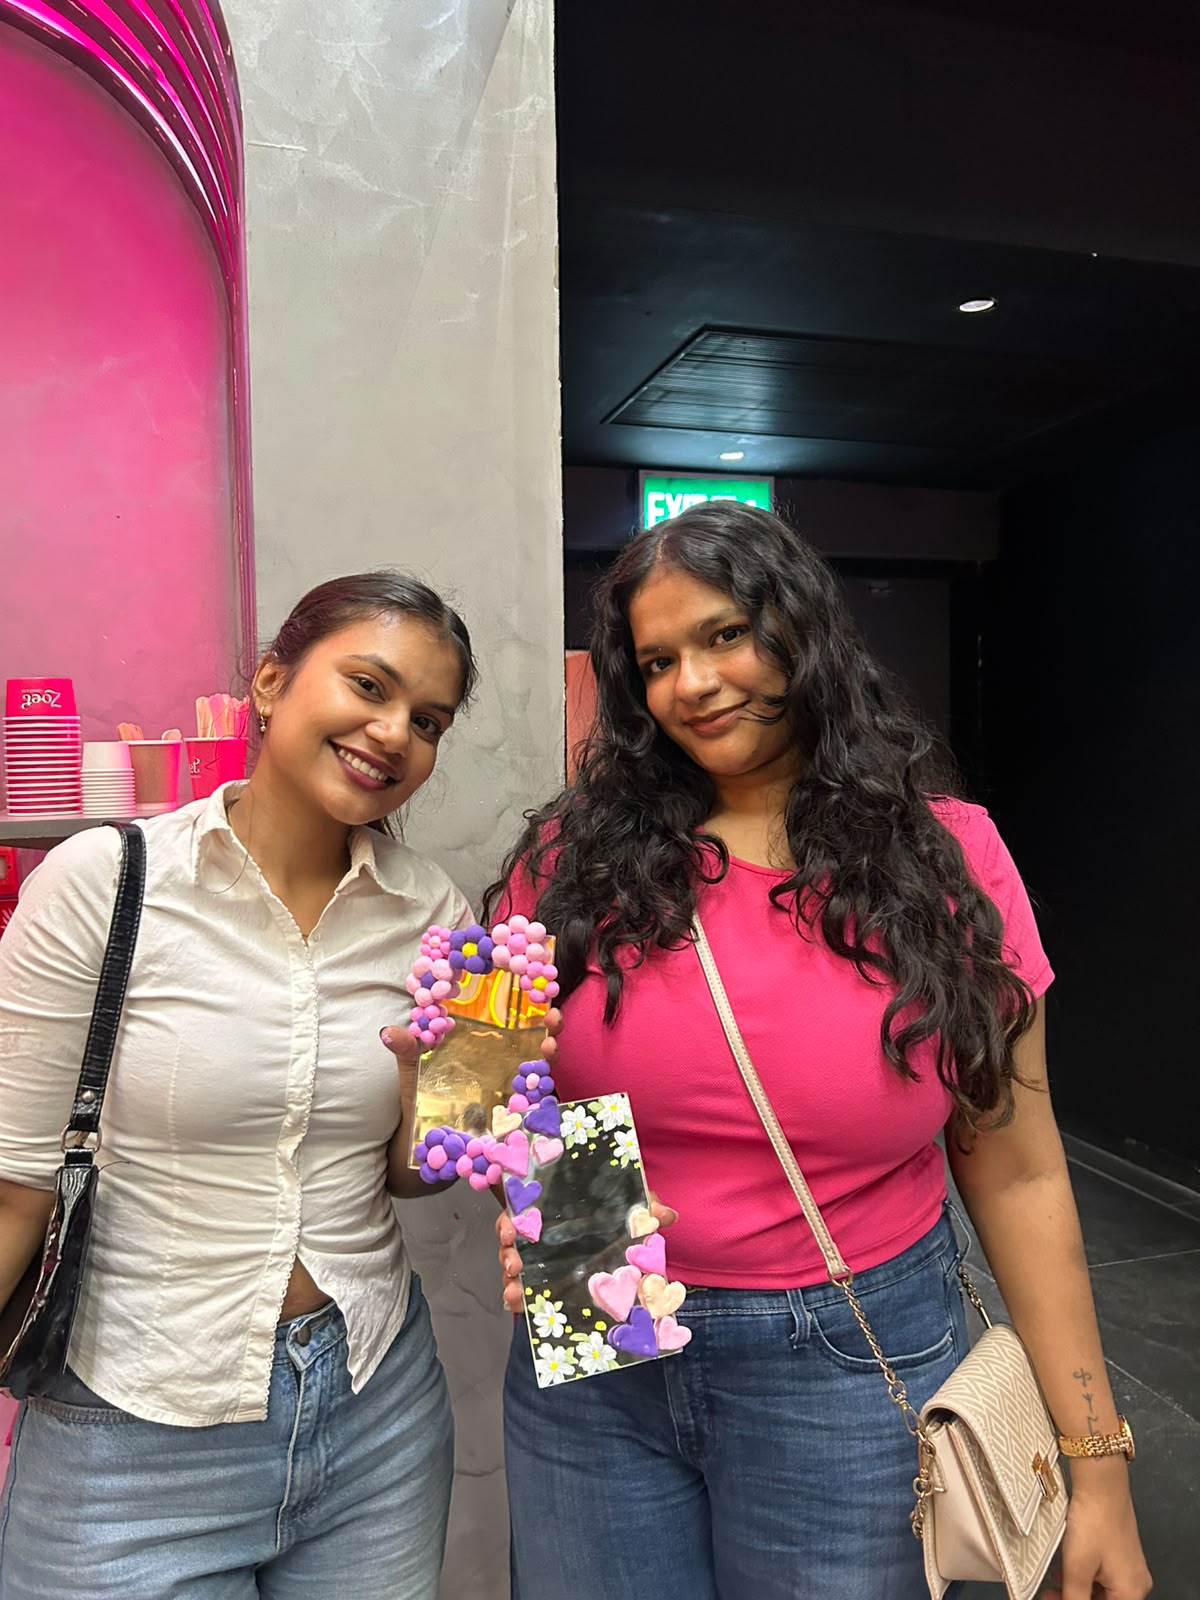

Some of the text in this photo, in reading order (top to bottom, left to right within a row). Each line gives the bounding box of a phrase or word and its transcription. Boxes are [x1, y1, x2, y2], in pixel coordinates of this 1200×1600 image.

[647, 491, 707, 529] EX
[21, 689, 62, 709] Zoet
[188, 757, 201, 774] et
